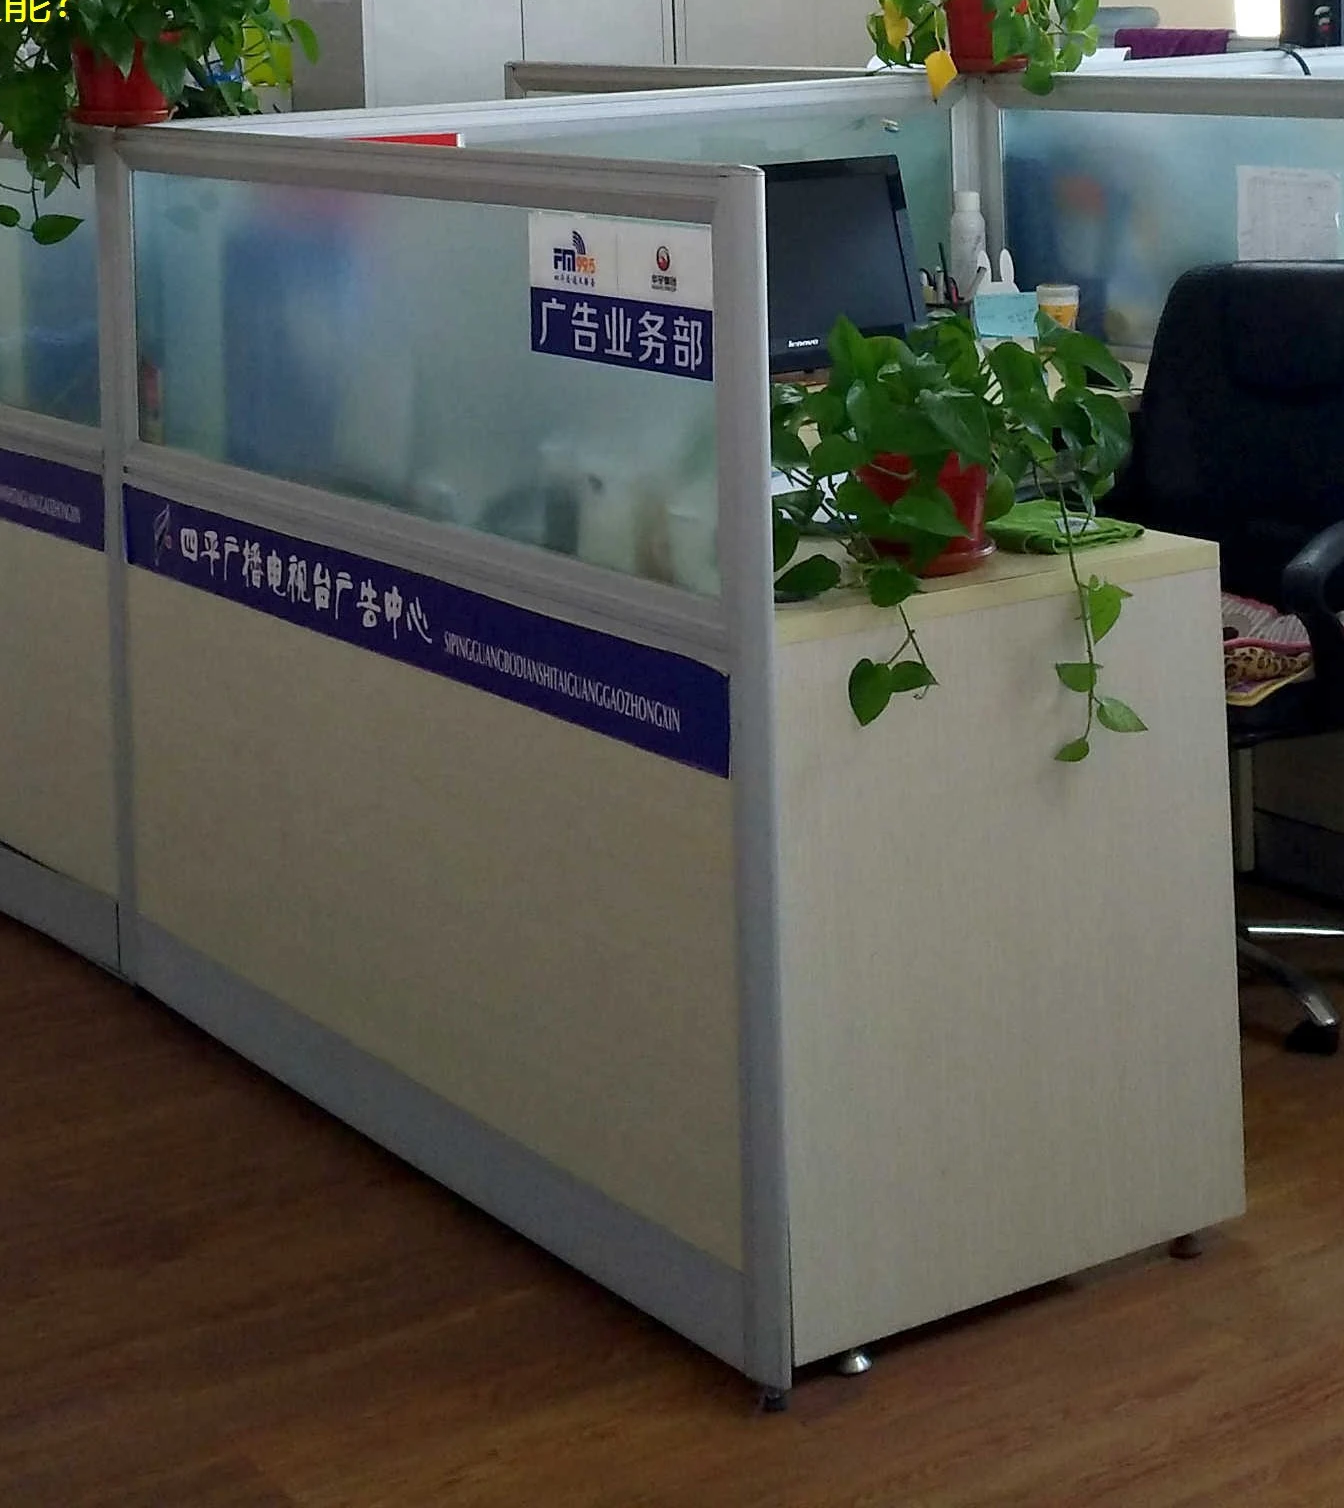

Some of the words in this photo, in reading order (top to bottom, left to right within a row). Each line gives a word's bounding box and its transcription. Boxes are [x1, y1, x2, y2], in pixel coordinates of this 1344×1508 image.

[539, 297, 703, 372] 广告业务部
[179, 527, 433, 644] 四平广播电视台广告中心
